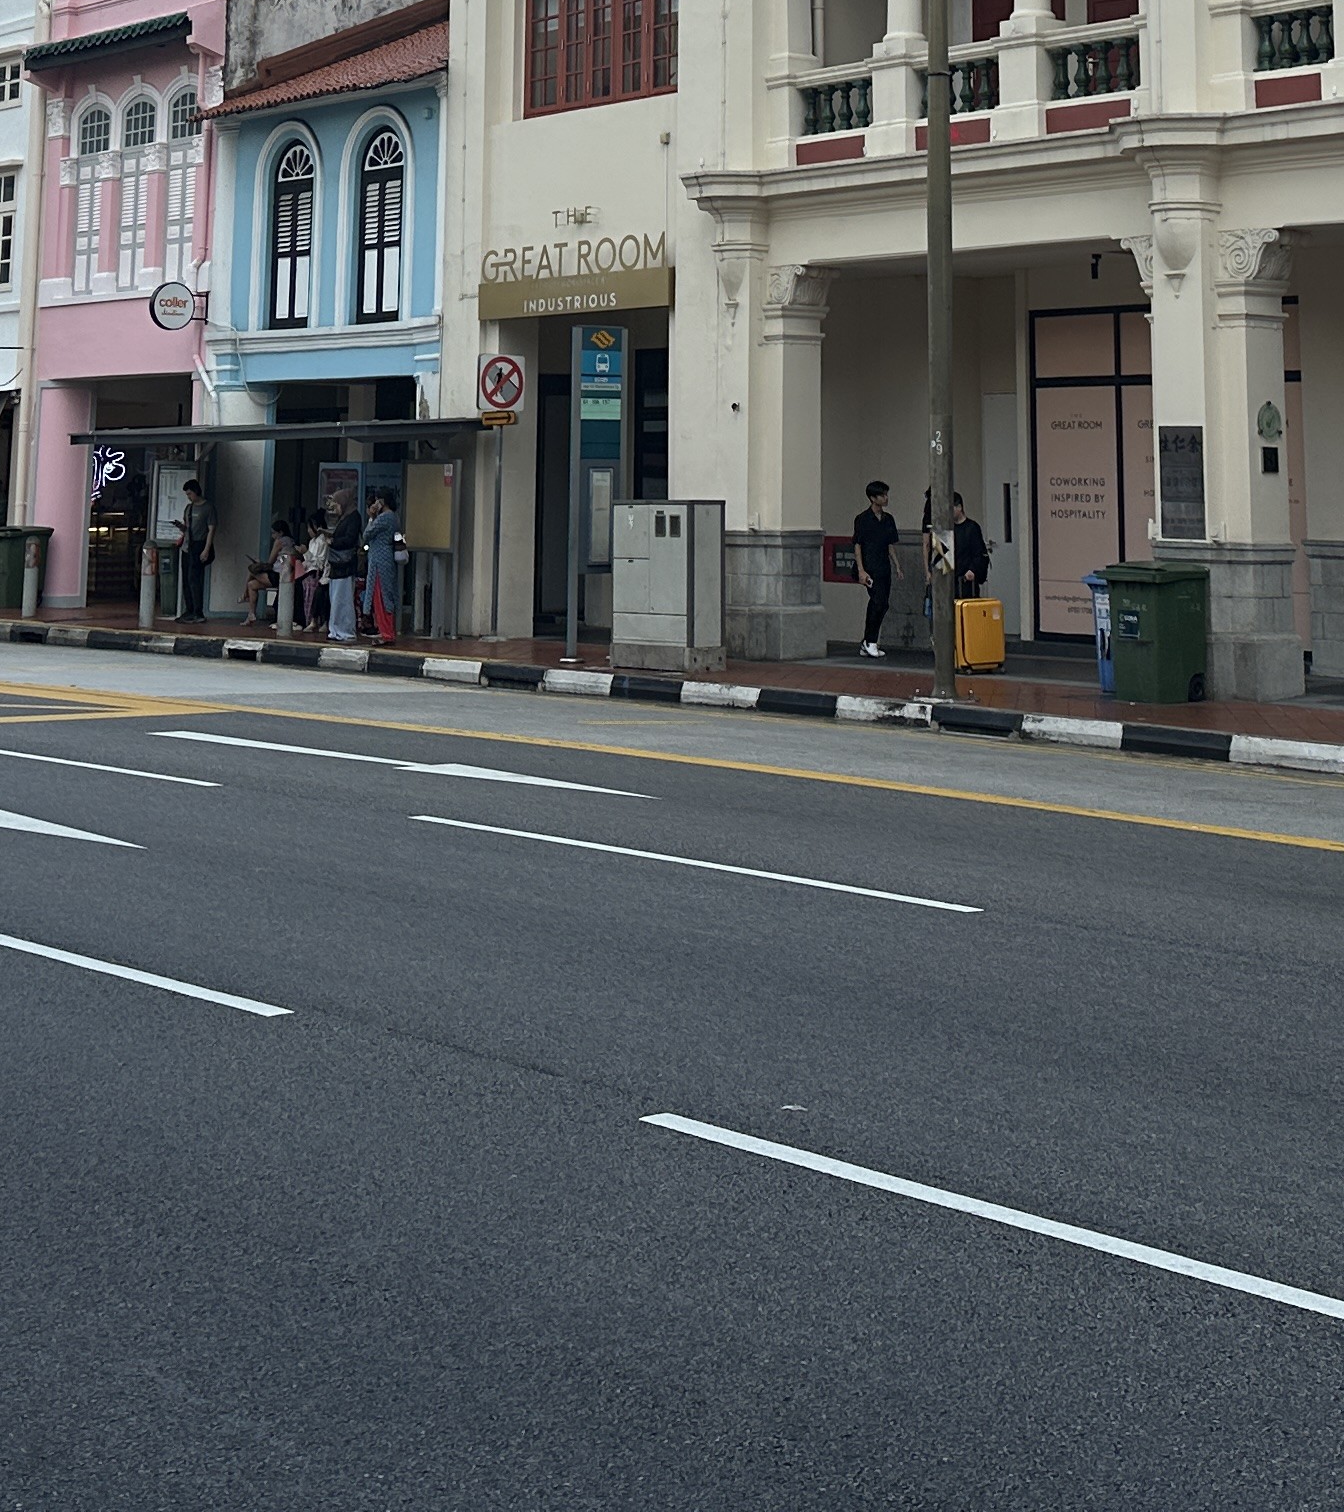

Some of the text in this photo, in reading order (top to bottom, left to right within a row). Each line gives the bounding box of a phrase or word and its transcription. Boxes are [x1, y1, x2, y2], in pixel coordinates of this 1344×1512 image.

[552, 206, 592, 229] THE
[482, 232, 665, 283] GREAT ROOM
[523, 292, 617, 313] INDUSTRIOUS
[1051, 420, 1103, 430] GREAT ROOM
[1050, 477, 1106, 487] COWORKING
[1051, 493, 1105, 503] INSPIRED BY
[1051, 510, 1106, 520] HOSPITALITY
